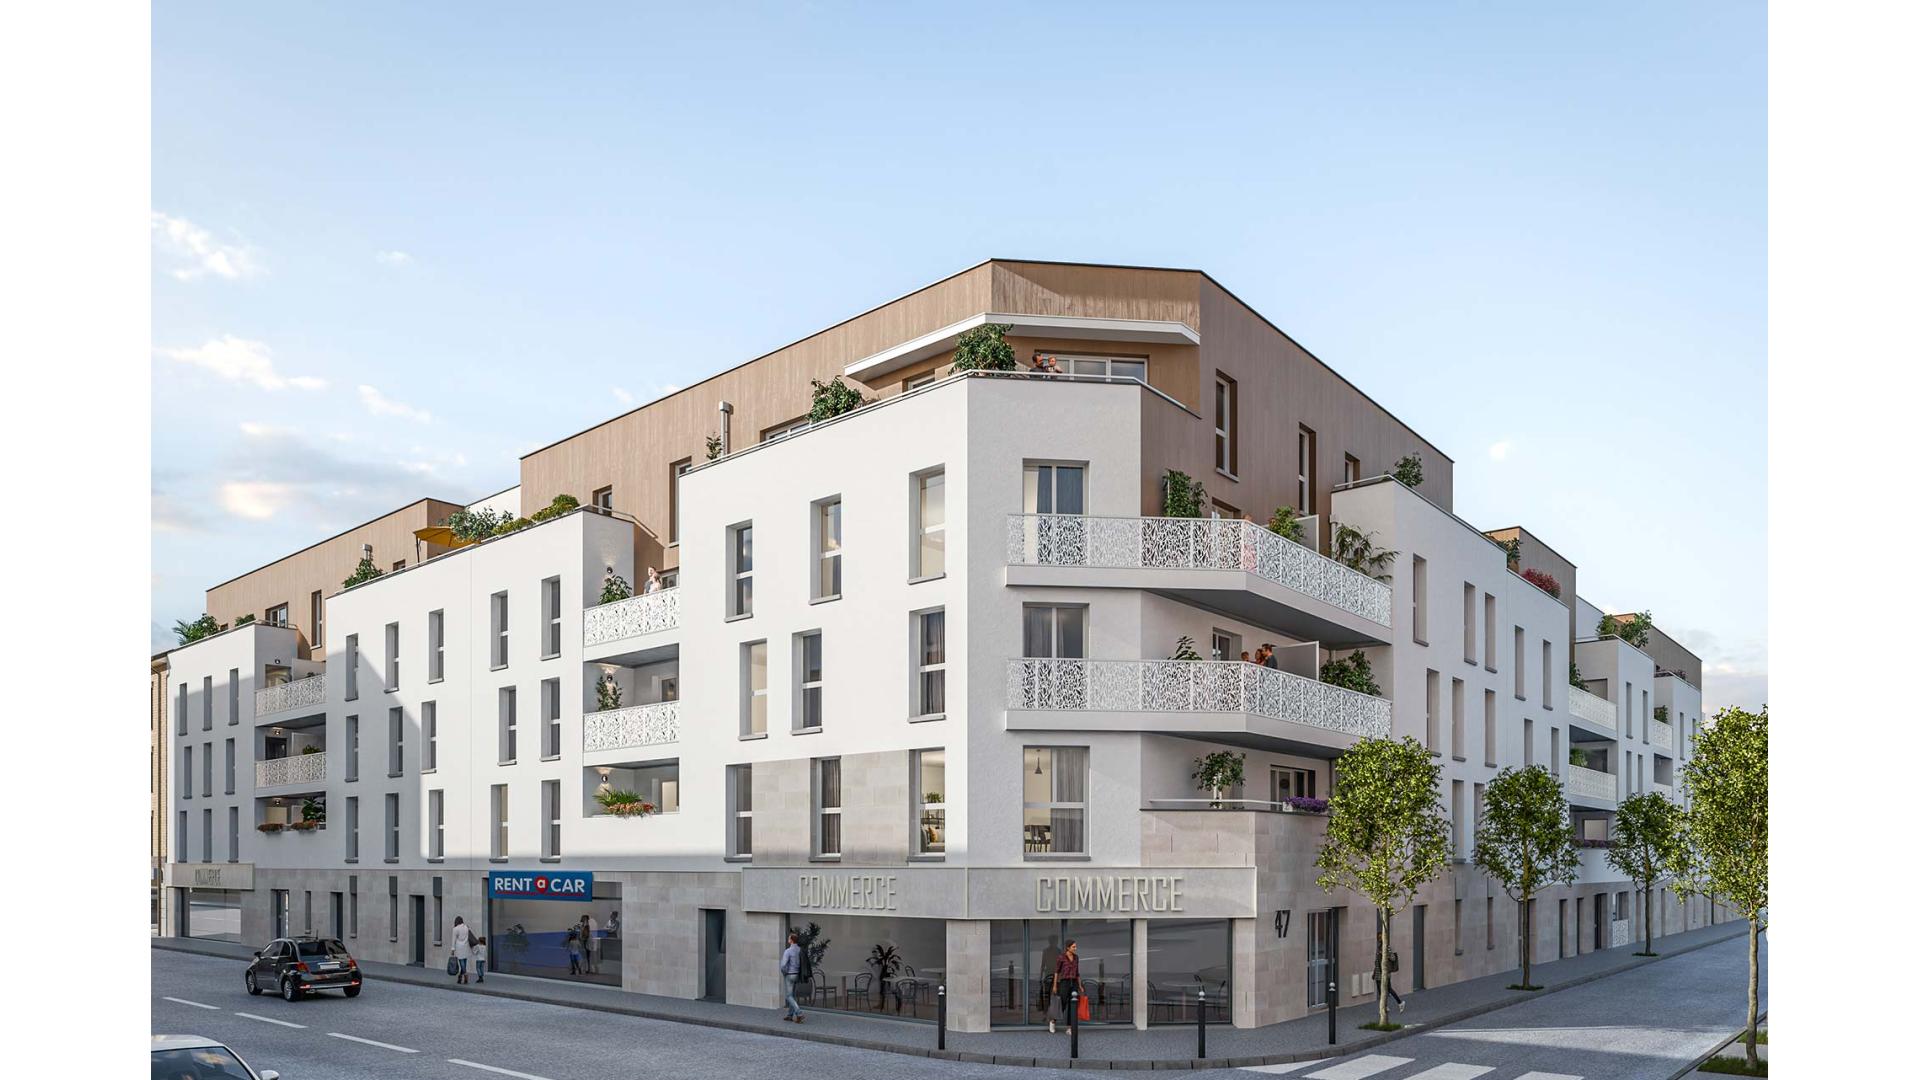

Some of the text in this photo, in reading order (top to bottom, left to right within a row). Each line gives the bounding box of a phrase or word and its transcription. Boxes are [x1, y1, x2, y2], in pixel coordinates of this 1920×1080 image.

[494, 877, 533, 891] RENT
[550, 878, 585, 893] CAR
[799, 875, 897, 910] COMMERCE
[1036, 876, 1184, 912] COMMERCE
[1274, 909, 1291, 938] 47
